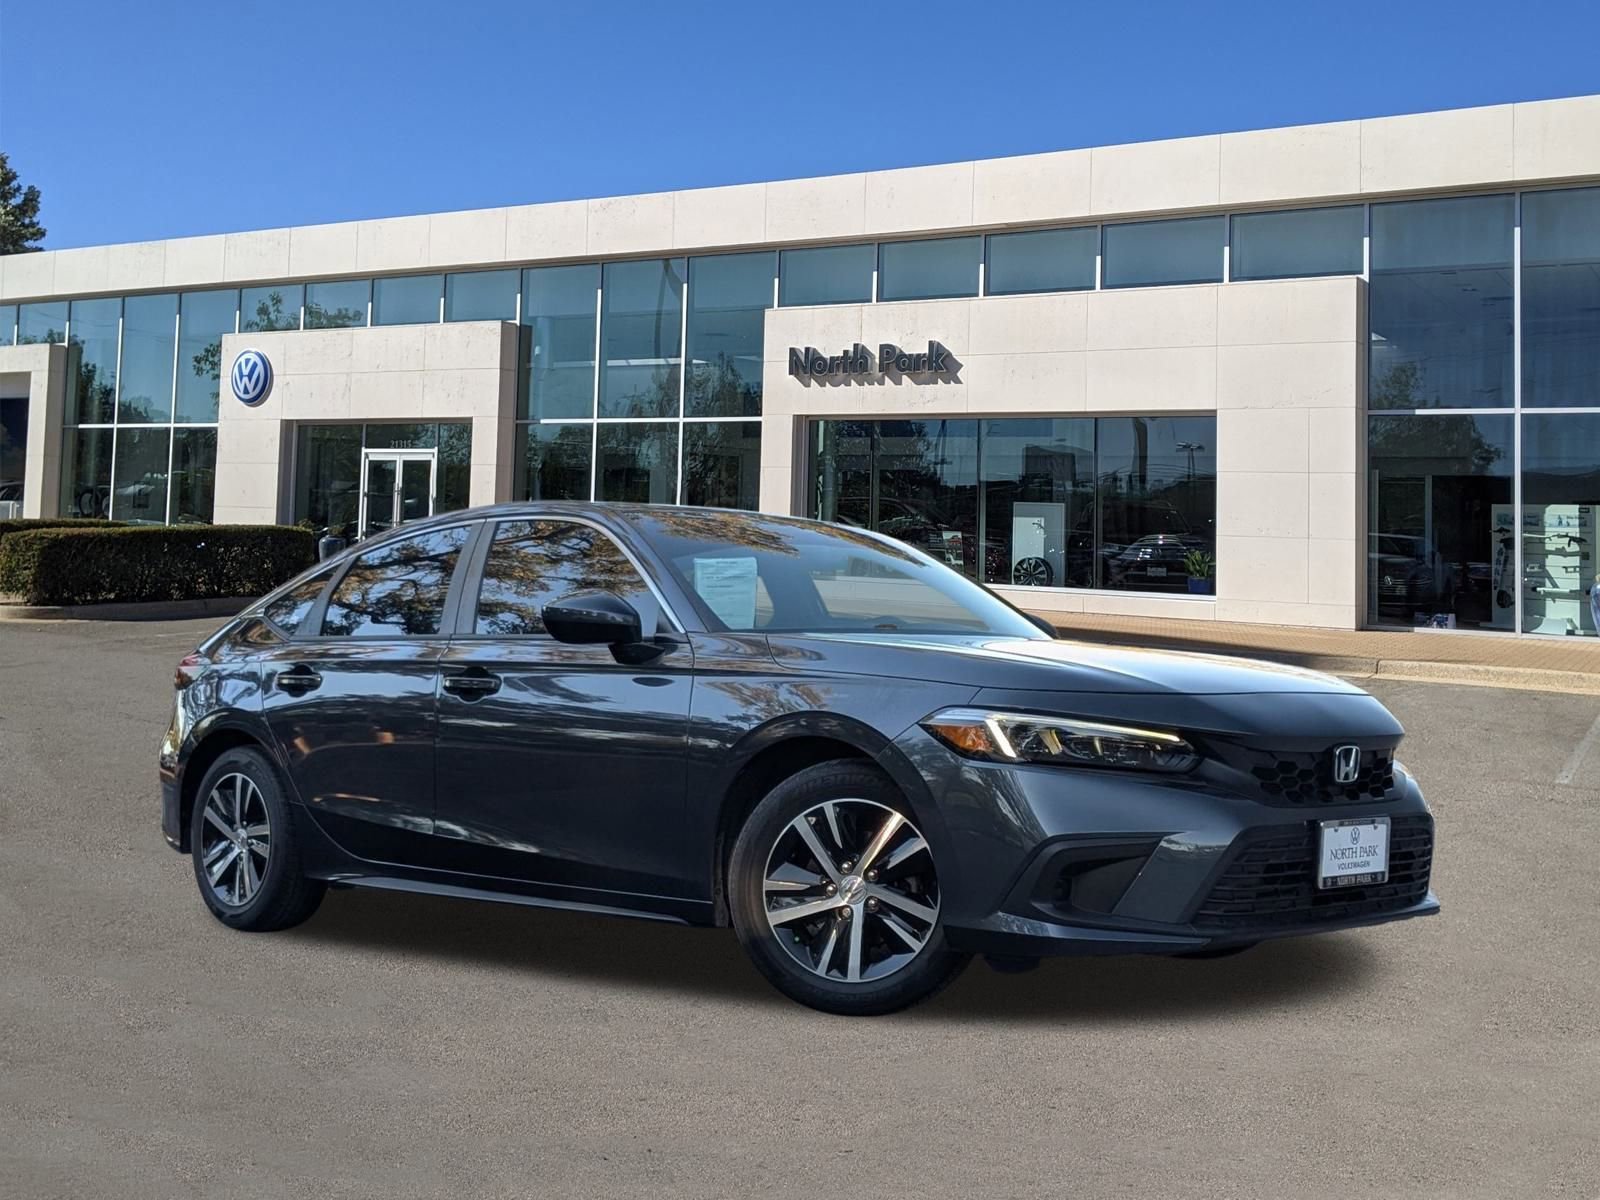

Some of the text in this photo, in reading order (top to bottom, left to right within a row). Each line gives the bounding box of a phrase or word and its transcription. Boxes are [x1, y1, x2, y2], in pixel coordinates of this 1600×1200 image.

[789, 341, 950, 376] North Park
[1330, 844, 1379, 860] NORTH PARK
[1337, 860, 1371, 871] VOLKSWAGEN
